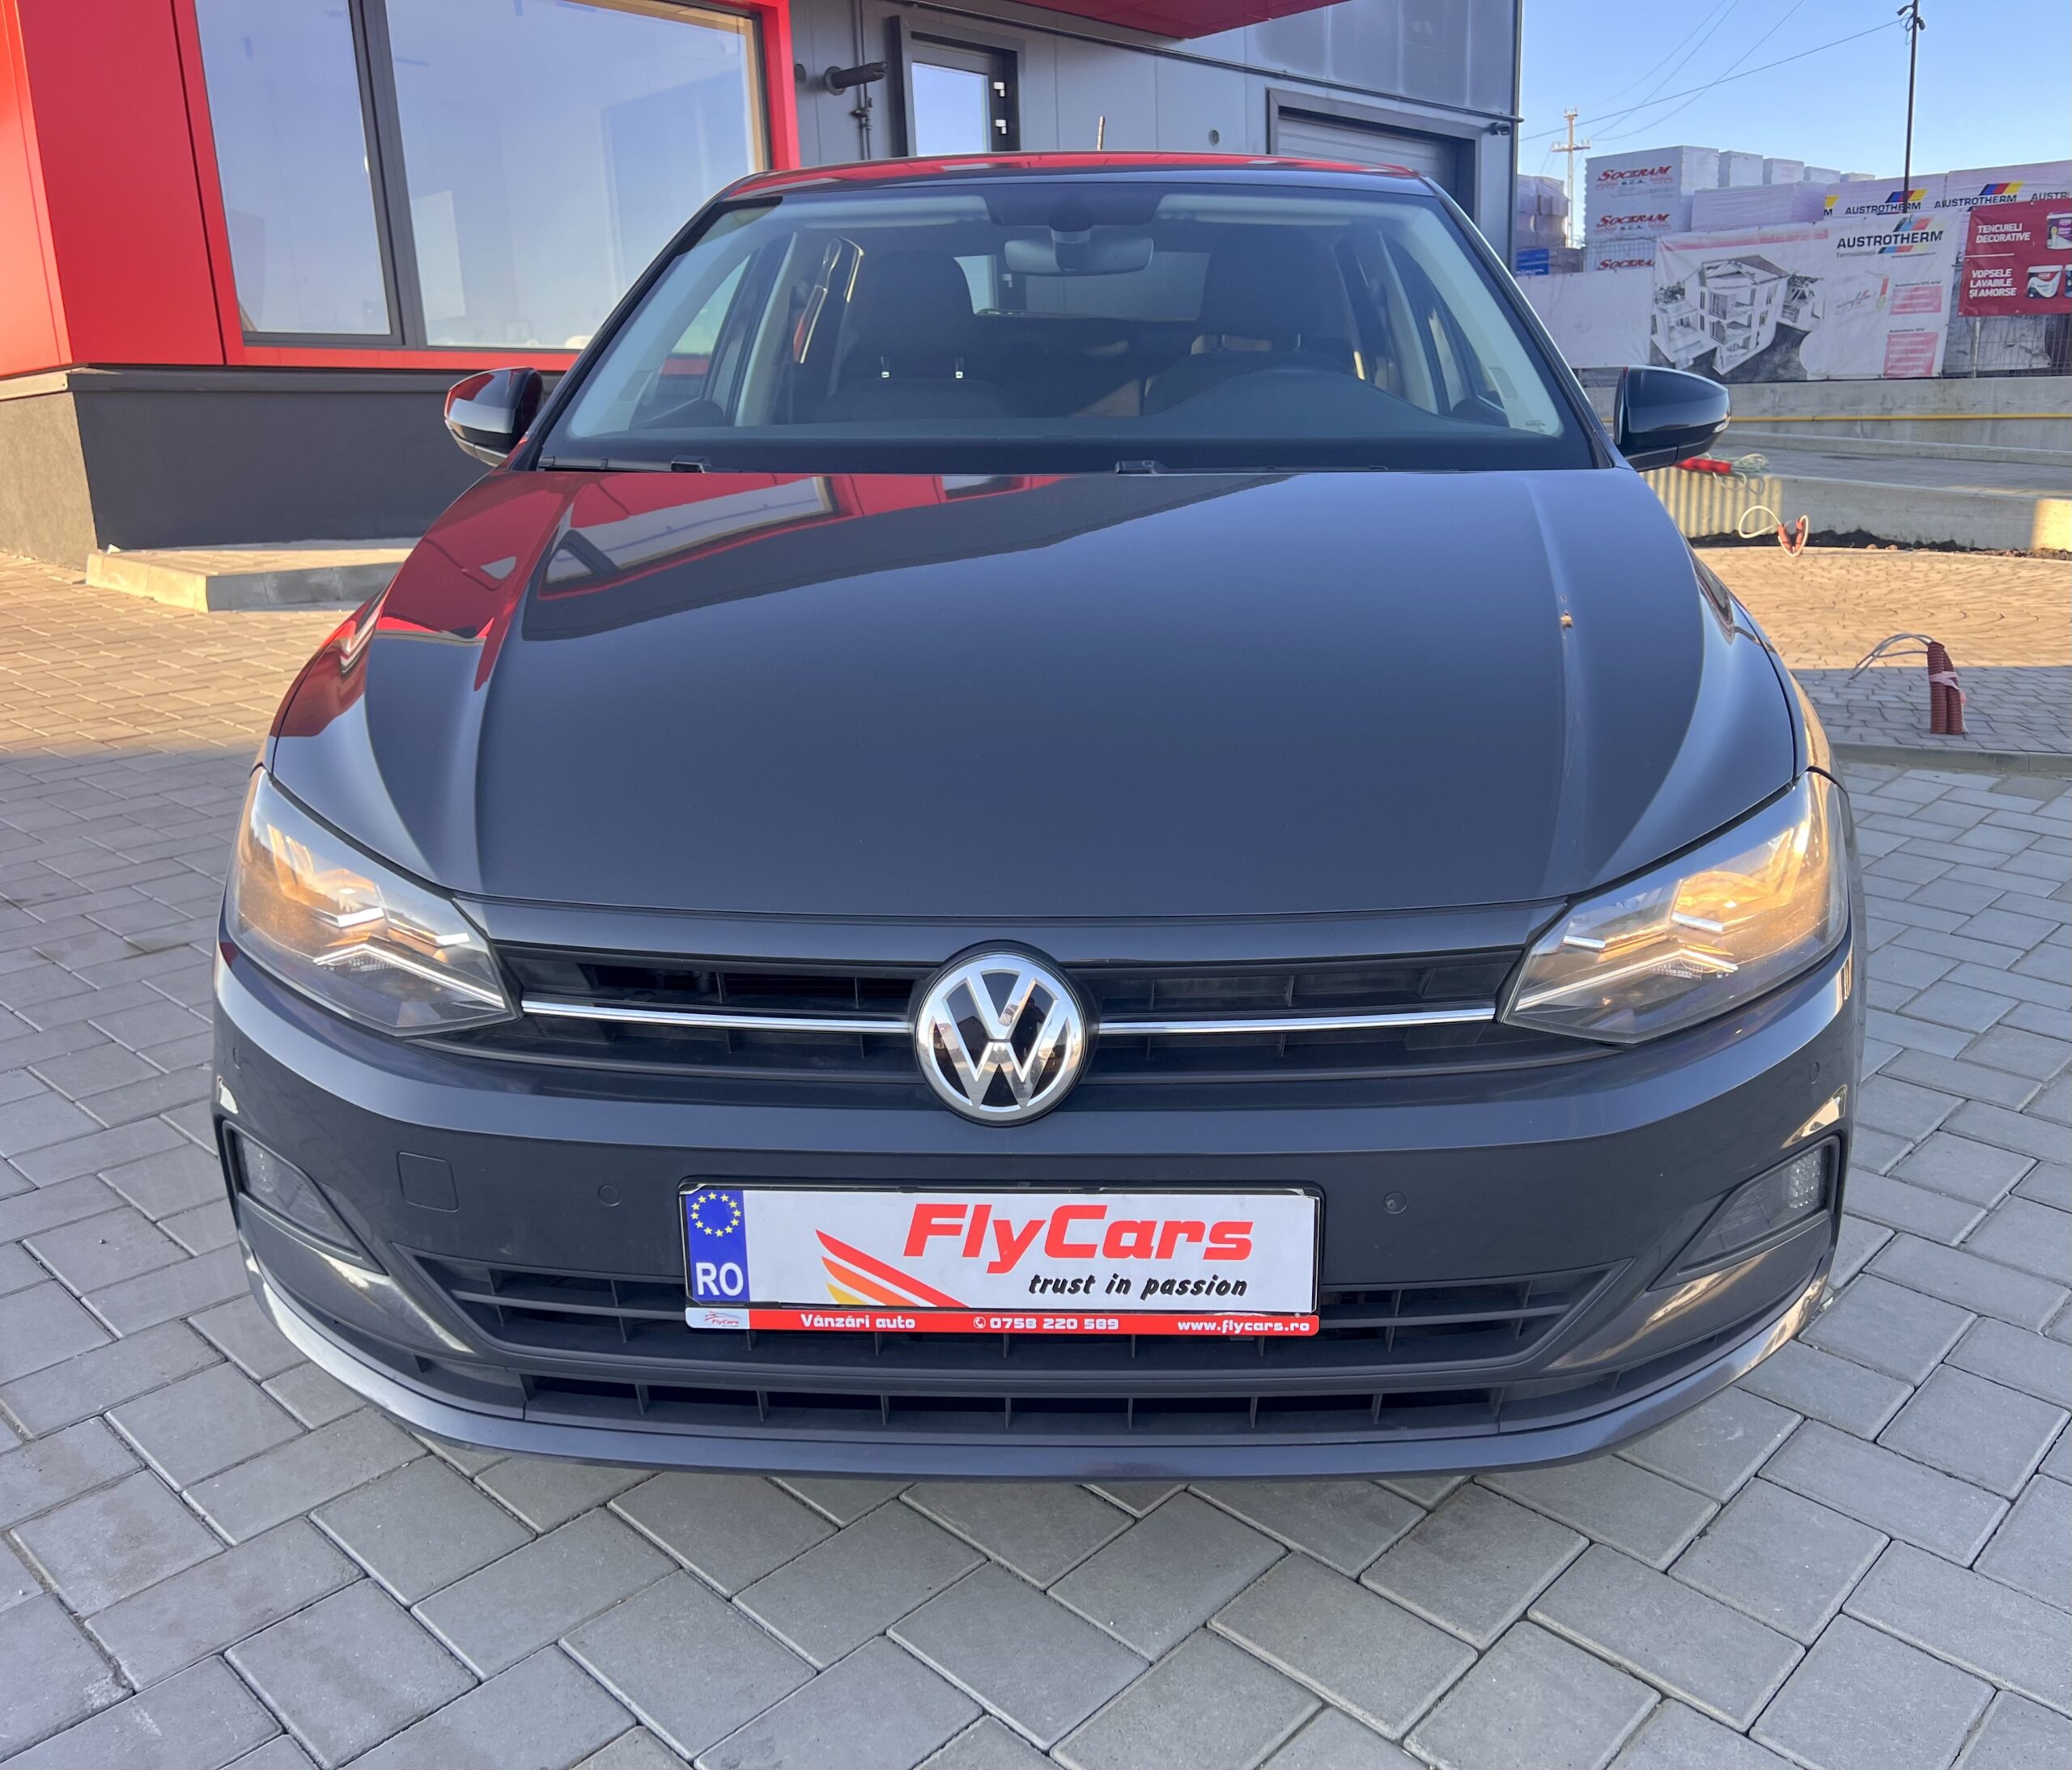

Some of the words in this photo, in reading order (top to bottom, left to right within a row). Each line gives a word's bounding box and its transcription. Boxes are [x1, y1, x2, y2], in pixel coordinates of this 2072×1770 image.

[1845, 202, 1921, 214] AUSTROTHERM
[1934, 194, 2018, 209] AUSTROTHERM
[1977, 223, 2023, 234] TENCUIELI
[1836, 230, 1943, 249] AUSTROTHERM
[1976, 231, 2031, 244] DECORATIVE
[1972, 268, 2012, 278] VOPSELE
[1969, 278, 2013, 288] LAVABILE
[1978, 287, 2017, 298] AMORSE
[903, 1203, 1254, 1274] FlyCars
[695, 1262, 744, 1297] RO
[1028, 1274, 1096, 1295] trust
[1105, 1273, 1132, 1295] in
[1140, 1275, 1248, 1301] passion
[875, 1315, 915, 1328] auto
[990, 1318, 1037, 1329] 0758
[1042, 1318, 1078, 1330] 220
[1084, 1318, 1119, 1330] 589
[1178, 1320, 1310, 1334] www.flycars.ro
